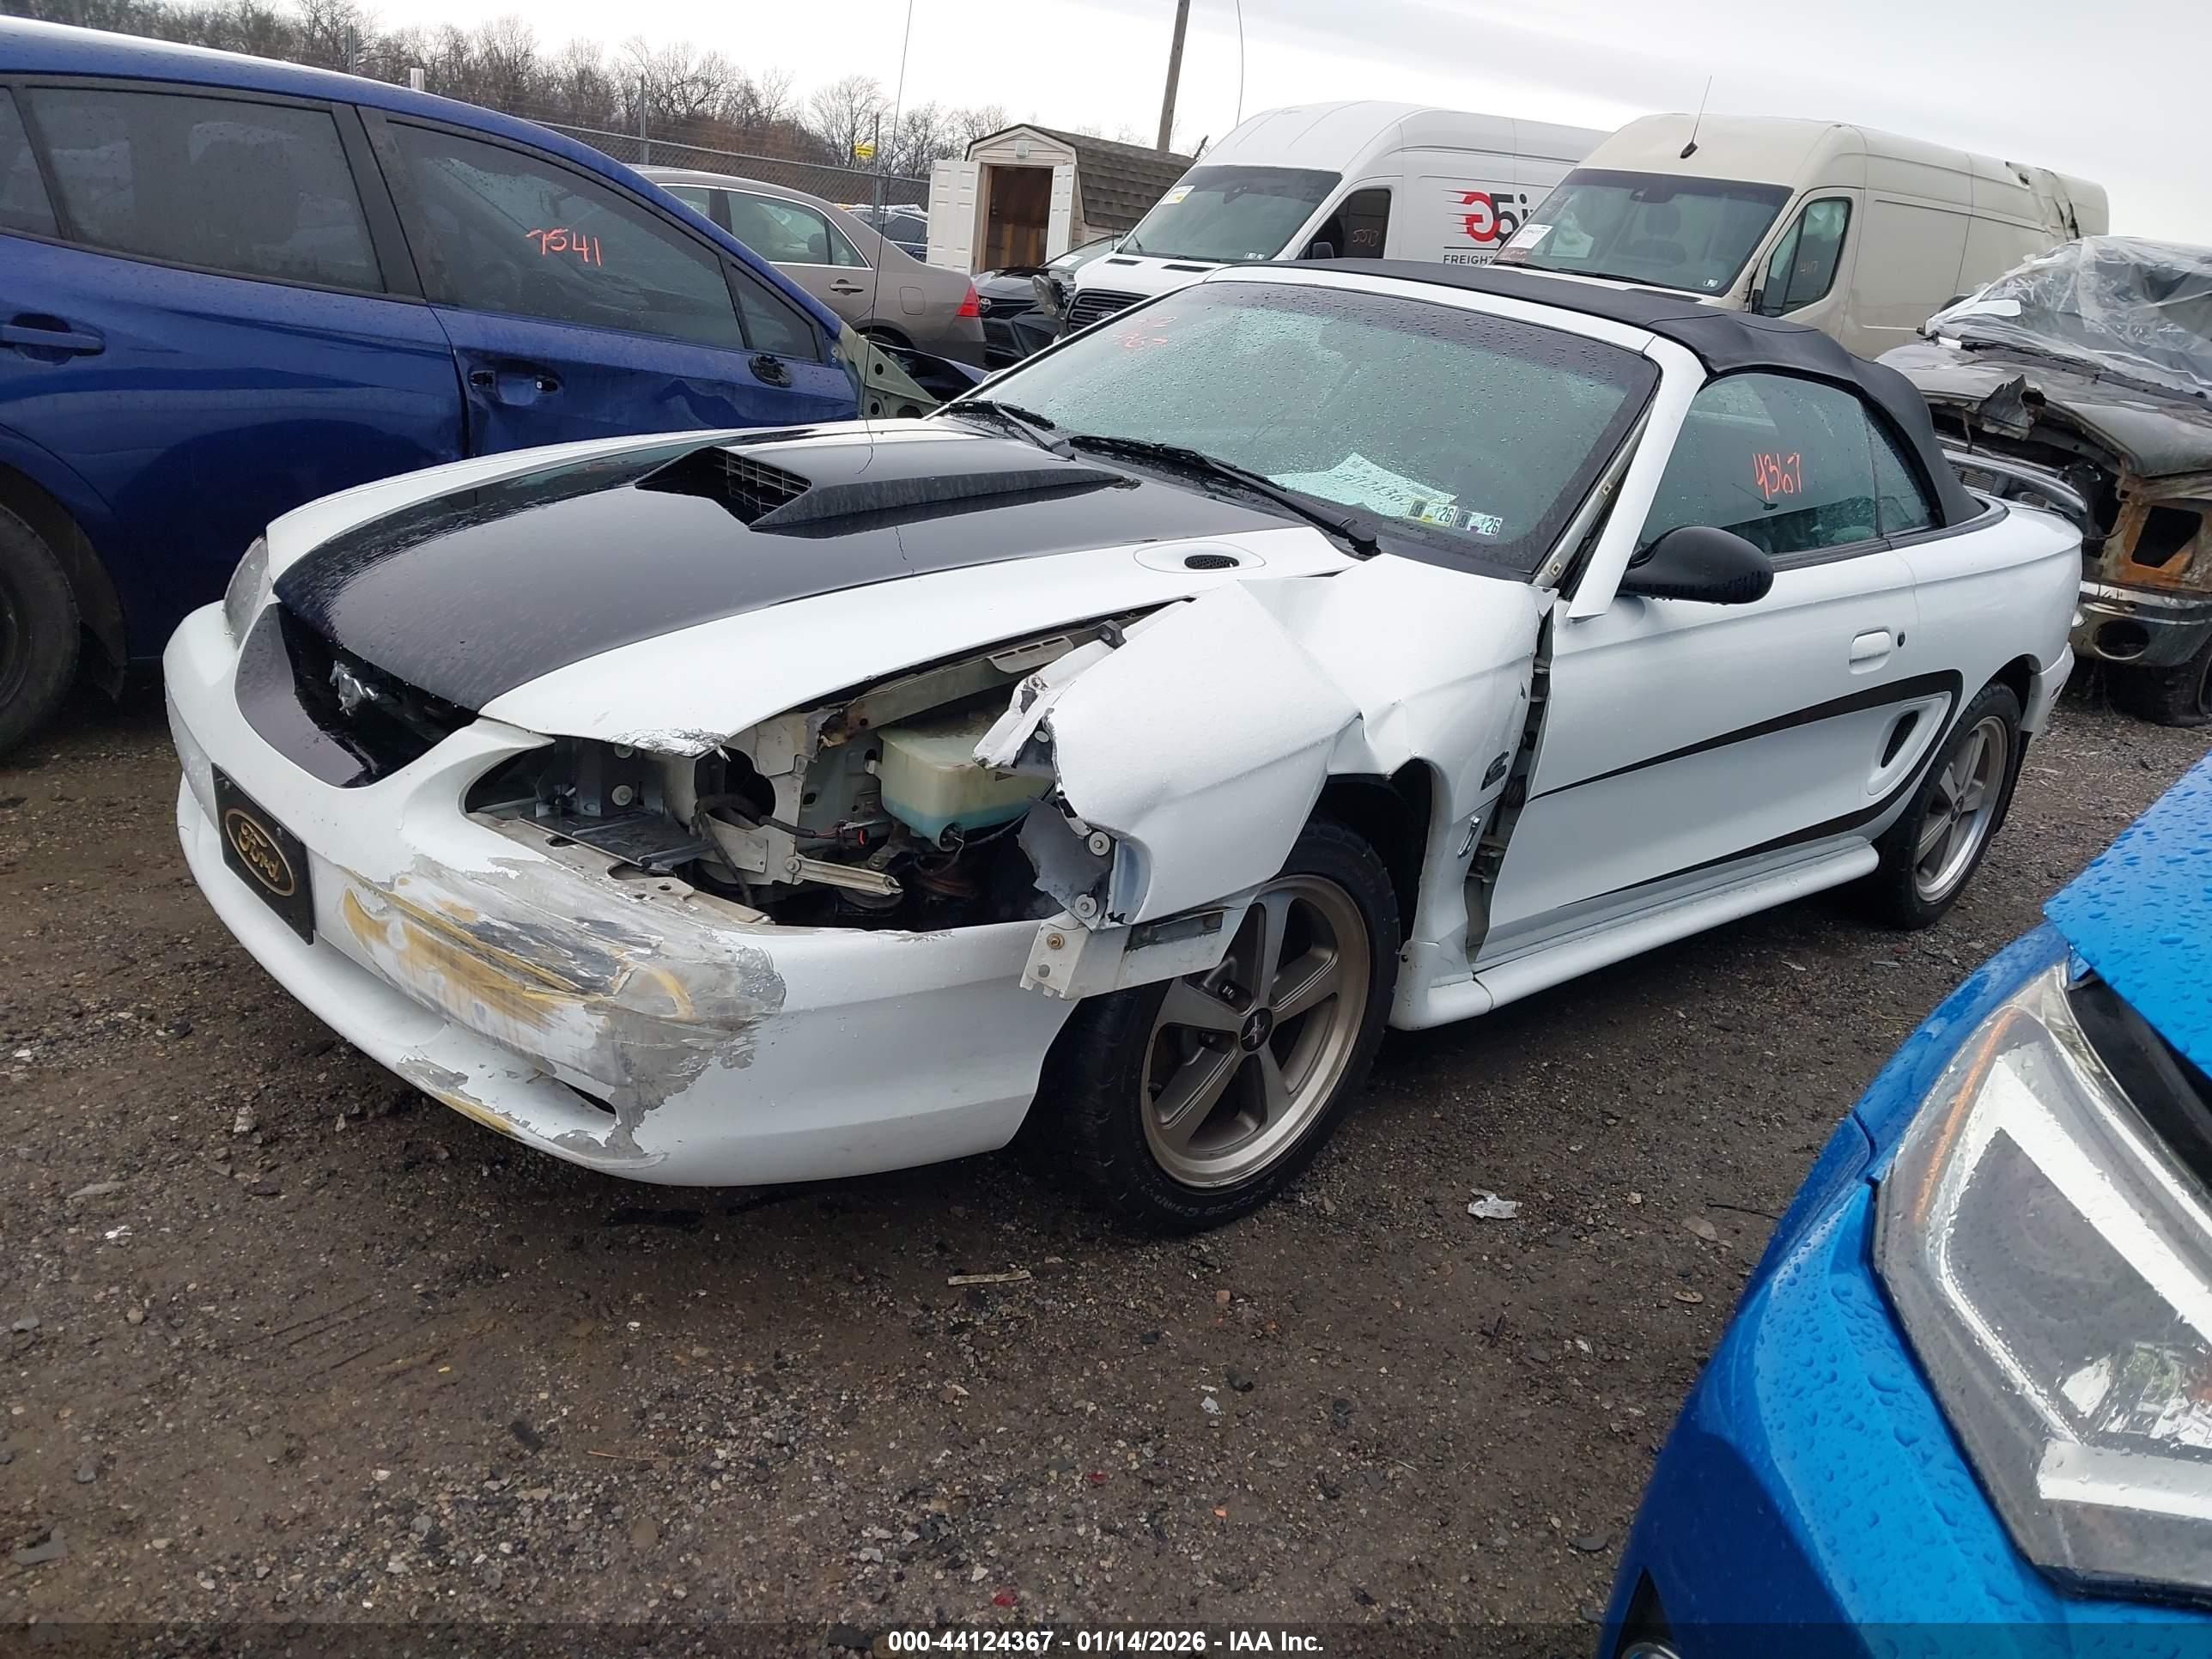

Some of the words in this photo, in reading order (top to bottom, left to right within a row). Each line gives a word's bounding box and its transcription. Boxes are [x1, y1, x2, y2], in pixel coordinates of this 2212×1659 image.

[526, 228, 602, 266] 7541
[1753, 452, 1802, 501] 4367
[1438, 507, 1455, 523] 26
[1485, 518, 1501, 534] 26
[238, 821, 280, 882] Ford
